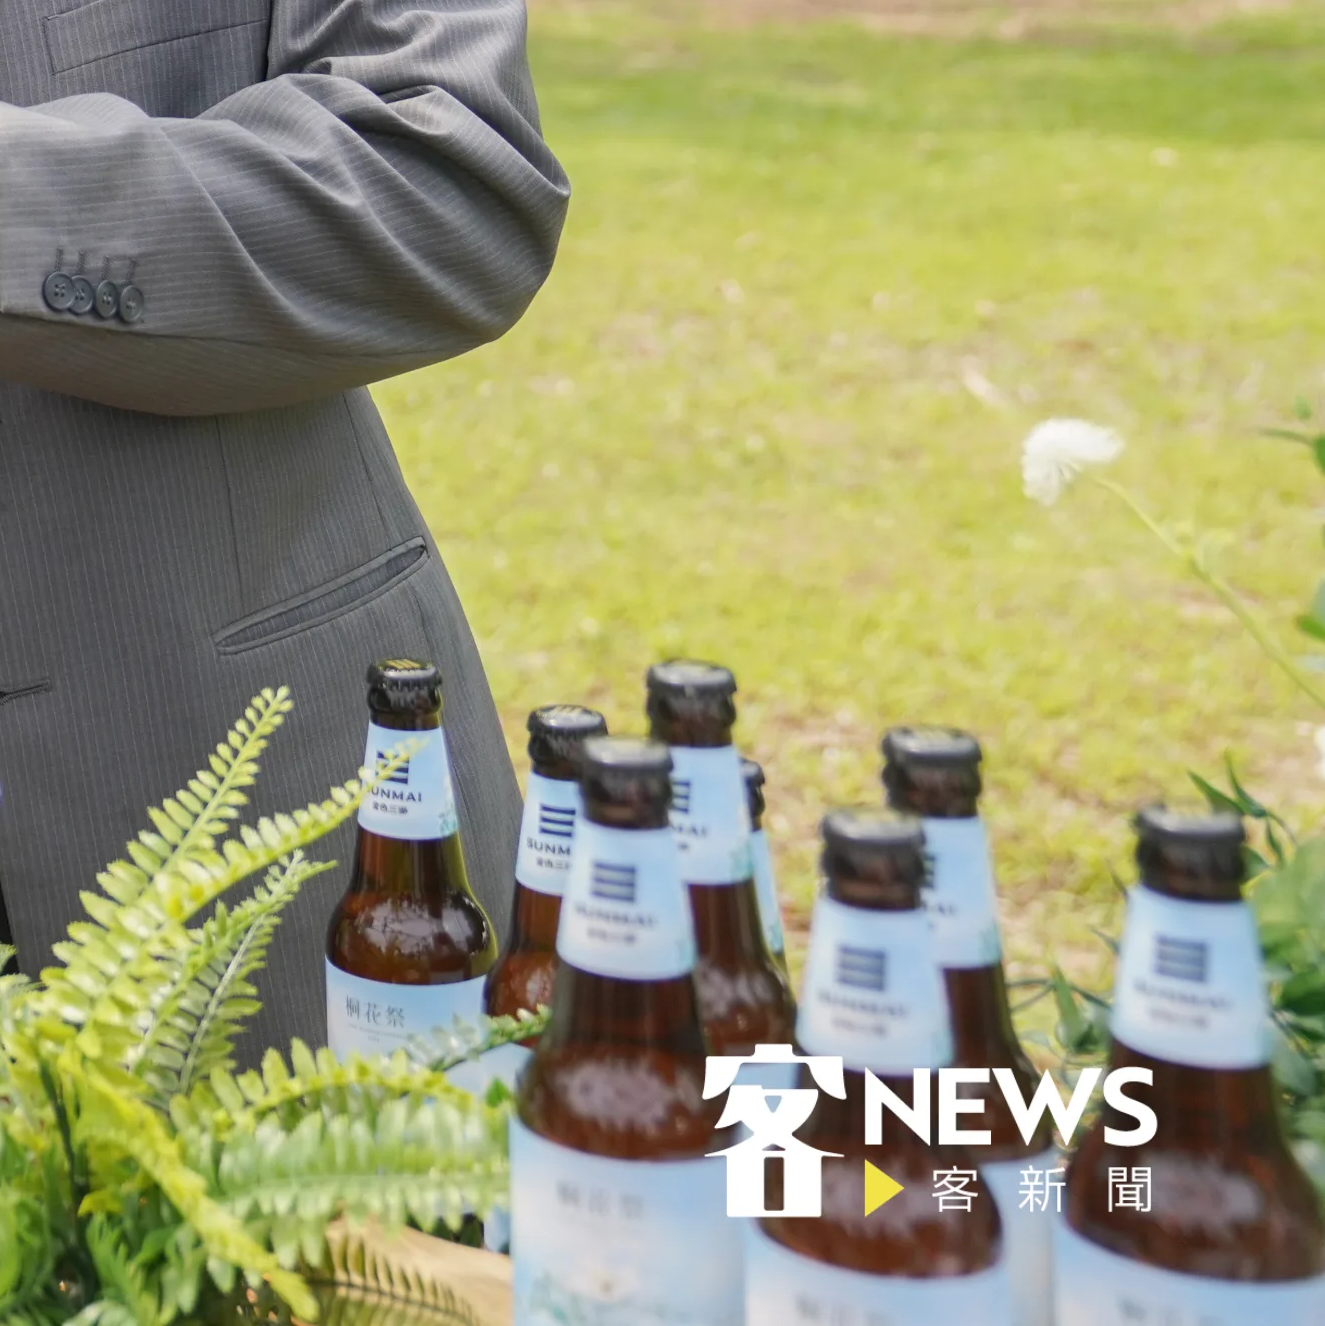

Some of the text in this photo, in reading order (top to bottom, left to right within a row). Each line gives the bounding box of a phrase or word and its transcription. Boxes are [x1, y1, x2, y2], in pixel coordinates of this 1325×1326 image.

[367, 785, 422, 802] UNMAI
[526, 836, 571, 856] SUNM
[345, 994, 405, 1029] 桐花祭
